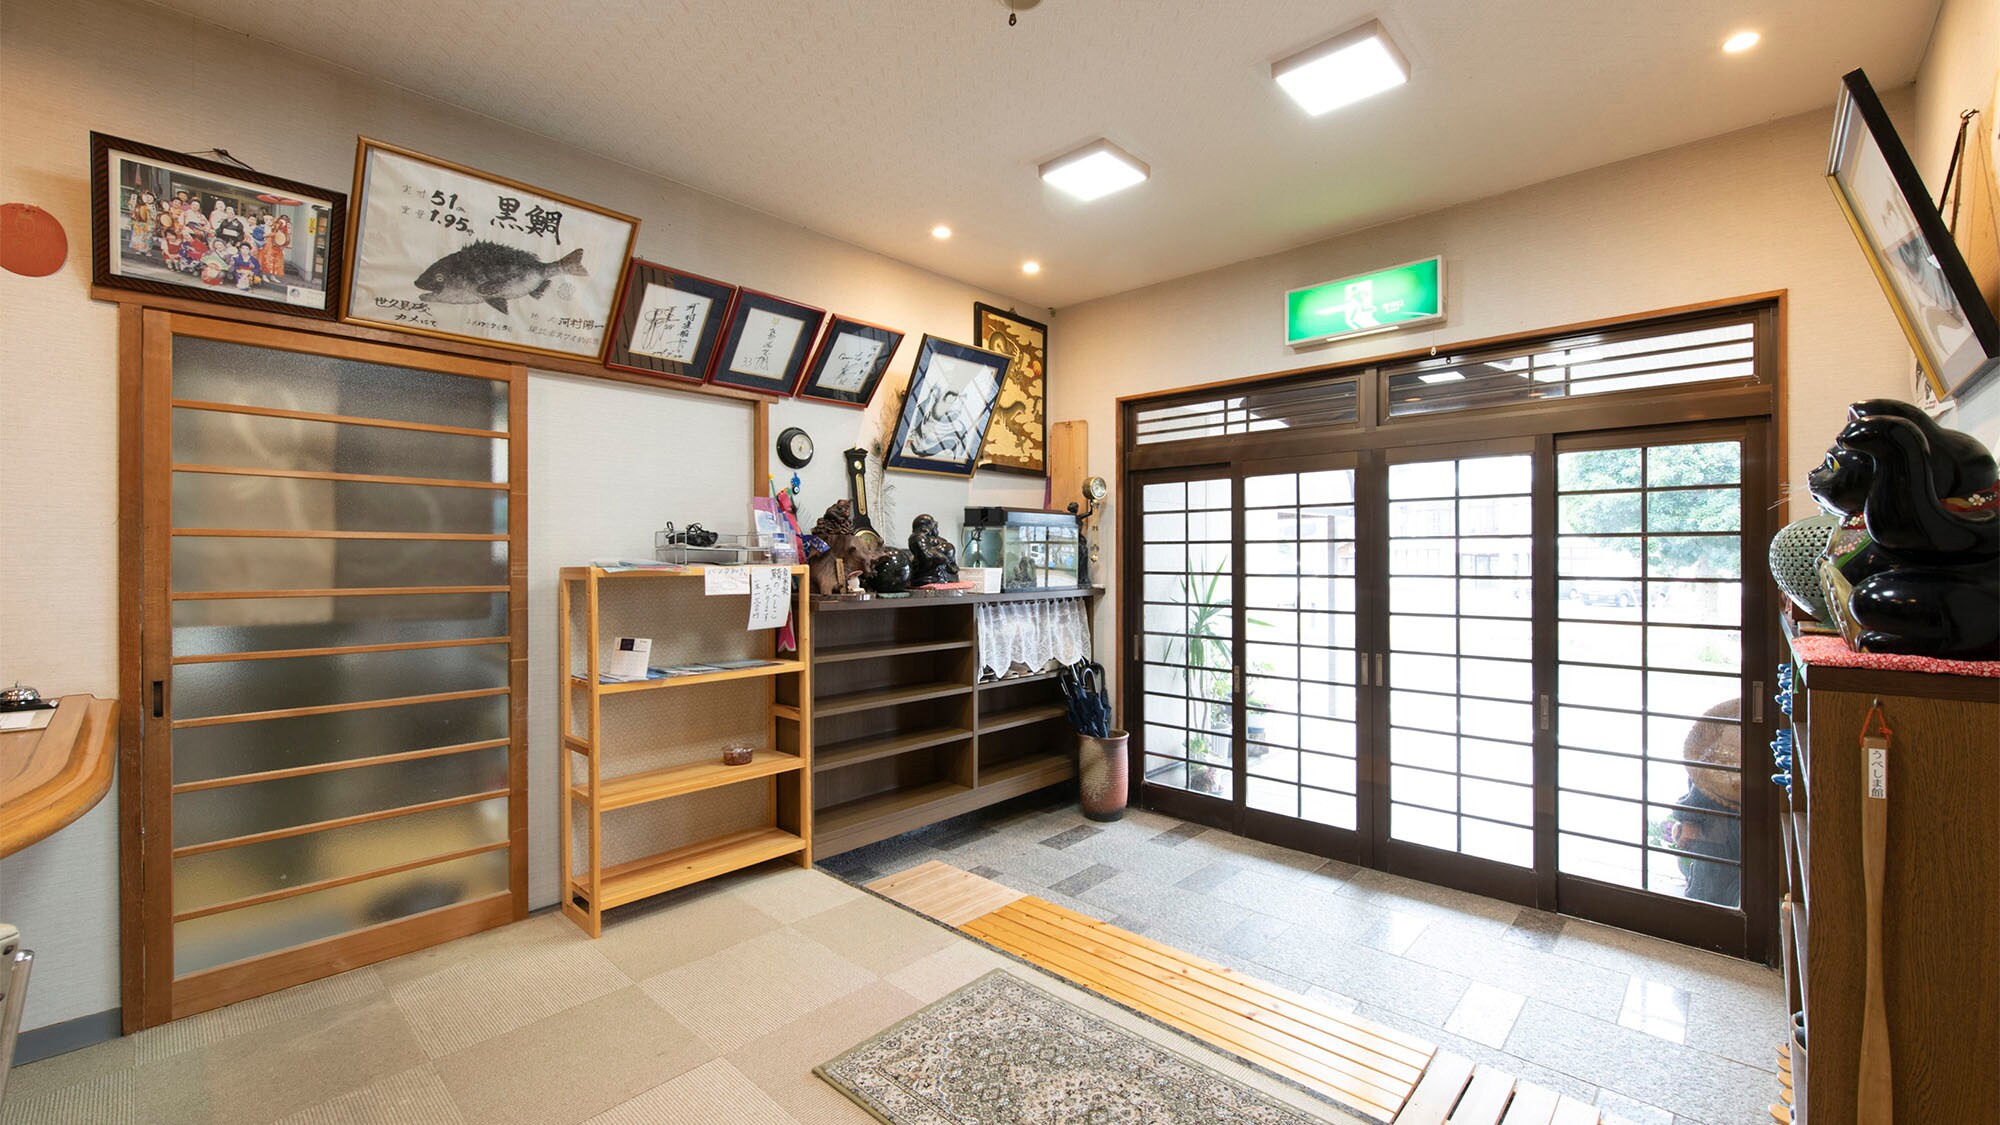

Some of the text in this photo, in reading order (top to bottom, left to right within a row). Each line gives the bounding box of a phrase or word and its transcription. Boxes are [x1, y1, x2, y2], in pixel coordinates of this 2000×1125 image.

[490, 195, 562, 245] 黒鯛
[1871, 750, 1884, 798] うべしま館
